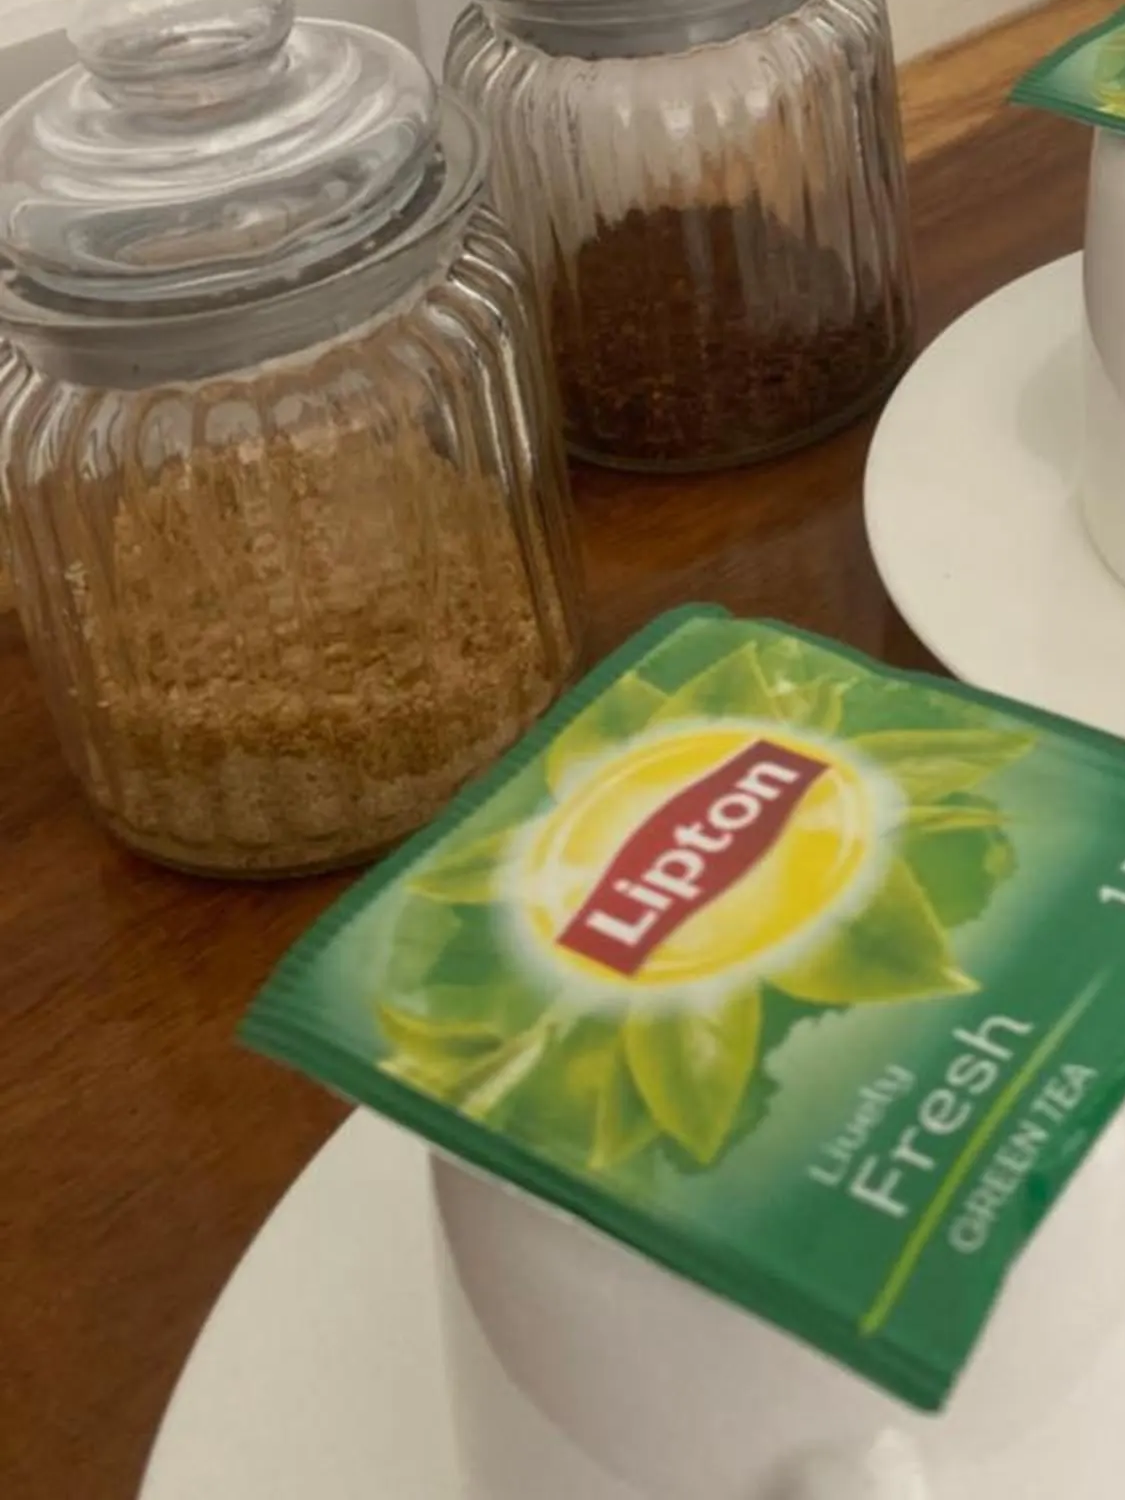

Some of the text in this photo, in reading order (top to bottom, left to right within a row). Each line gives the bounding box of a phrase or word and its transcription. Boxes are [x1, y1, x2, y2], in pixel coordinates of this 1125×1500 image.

[585, 760, 802, 948] Lipton
[848, 1011, 1035, 1218] Fresh
[947, 1061, 1099, 1254] GREEN TEA
